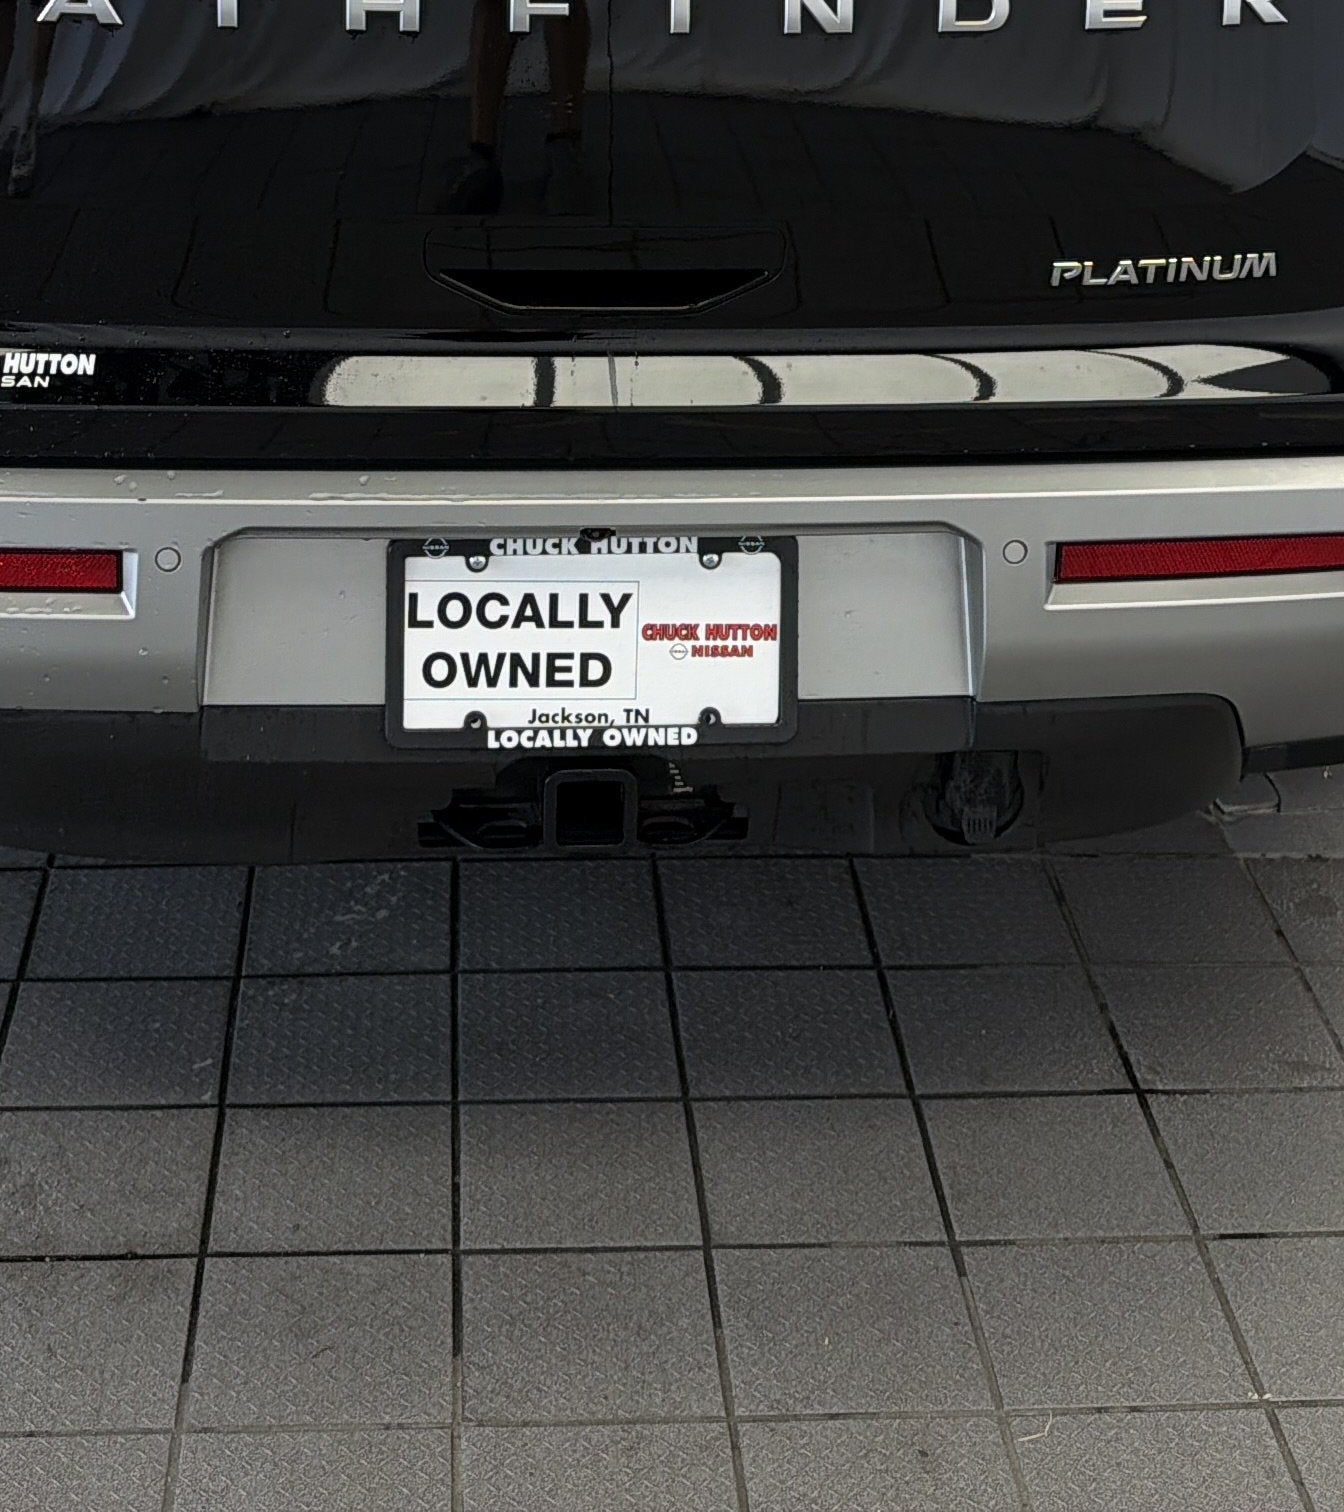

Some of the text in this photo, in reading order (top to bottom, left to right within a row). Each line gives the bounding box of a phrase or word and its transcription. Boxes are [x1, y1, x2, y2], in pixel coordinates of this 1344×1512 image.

[1050, 252, 1277, 286] PLATINUM
[3, 352, 96, 375] HUTTON
[489, 536, 698, 555] CHUCK HUTTON
[408, 592, 633, 629] LOCALLY
[641, 623, 778, 641] CHUCK HUTTON
[691, 645, 754, 657] NISSAN
[422, 652, 612, 689] OWNED
[528, 707, 650, 728] Jackson, TN
[487, 727, 698, 748] LOCALLY OWNED
